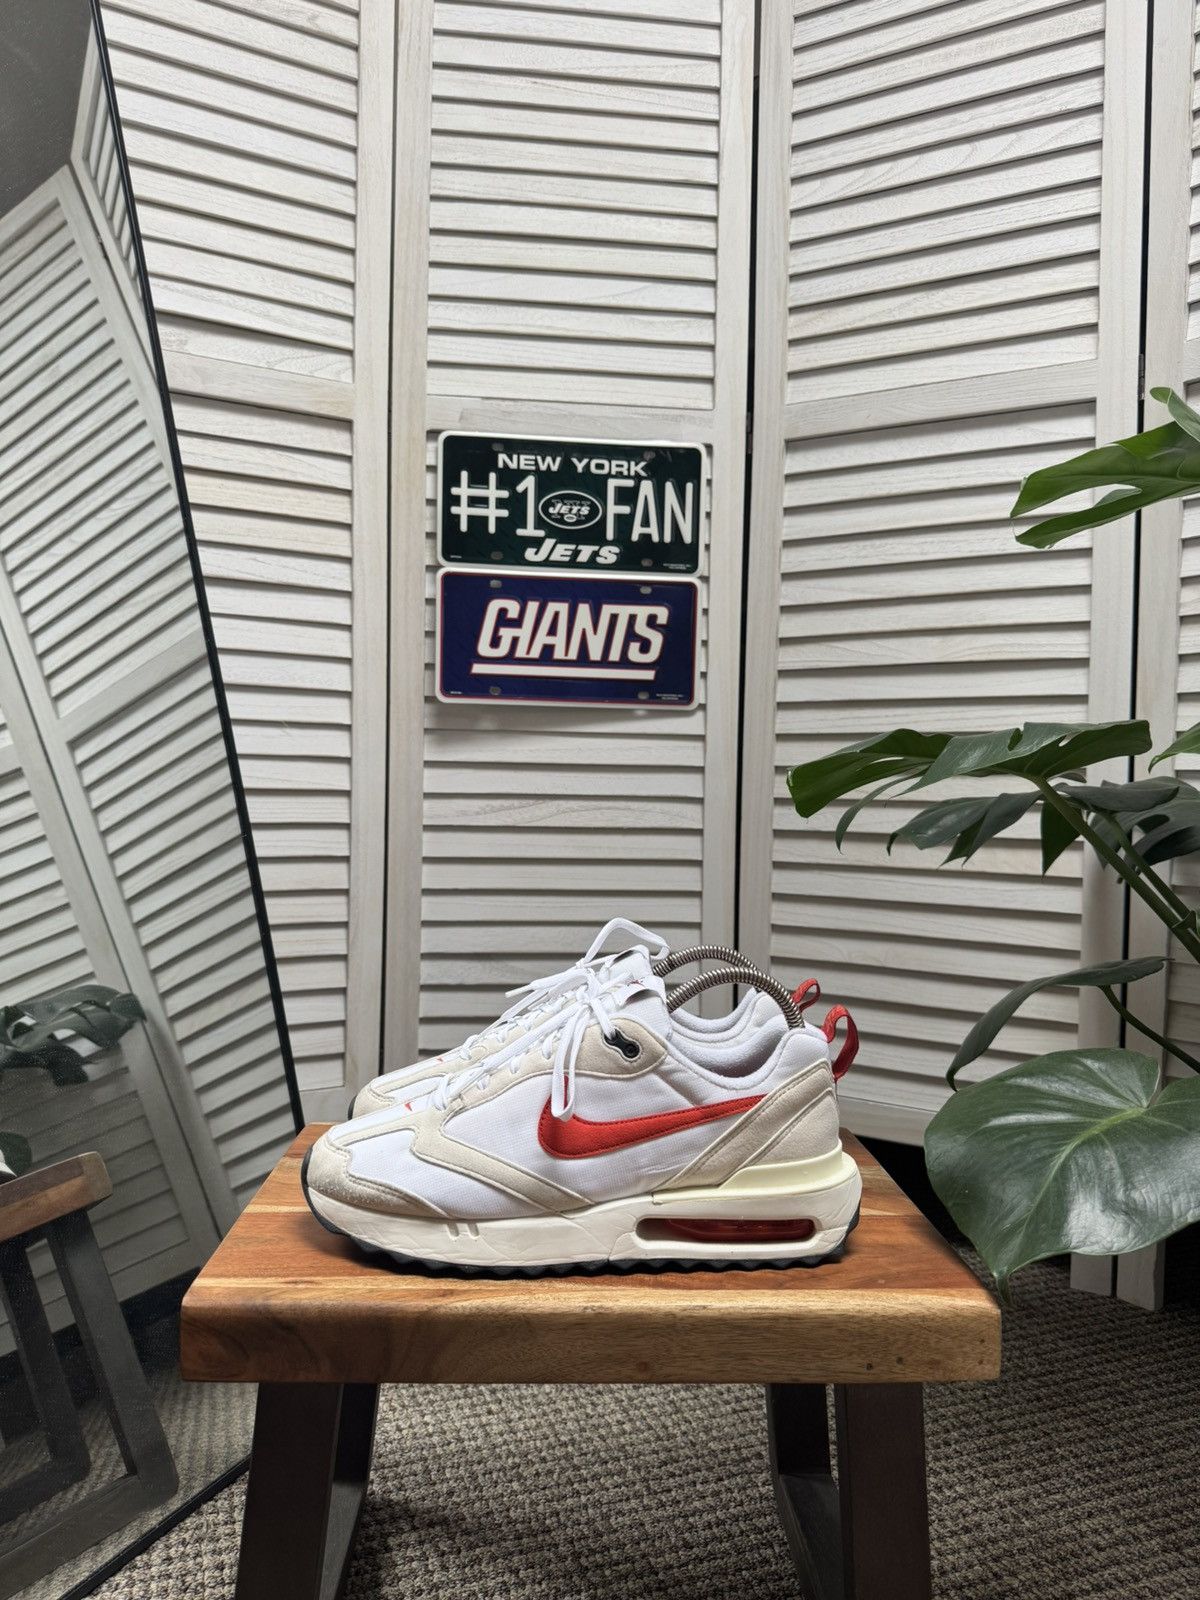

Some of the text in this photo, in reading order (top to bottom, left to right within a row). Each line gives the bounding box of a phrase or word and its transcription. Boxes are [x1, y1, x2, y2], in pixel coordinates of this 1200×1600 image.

[498, 453, 648, 477] NEW YORK
[450, 470, 693, 544] #1 FAN
[548, 502, 591, 515] JETS
[524, 538, 620, 564] JETS
[476, 598, 670, 664] GIANTS
